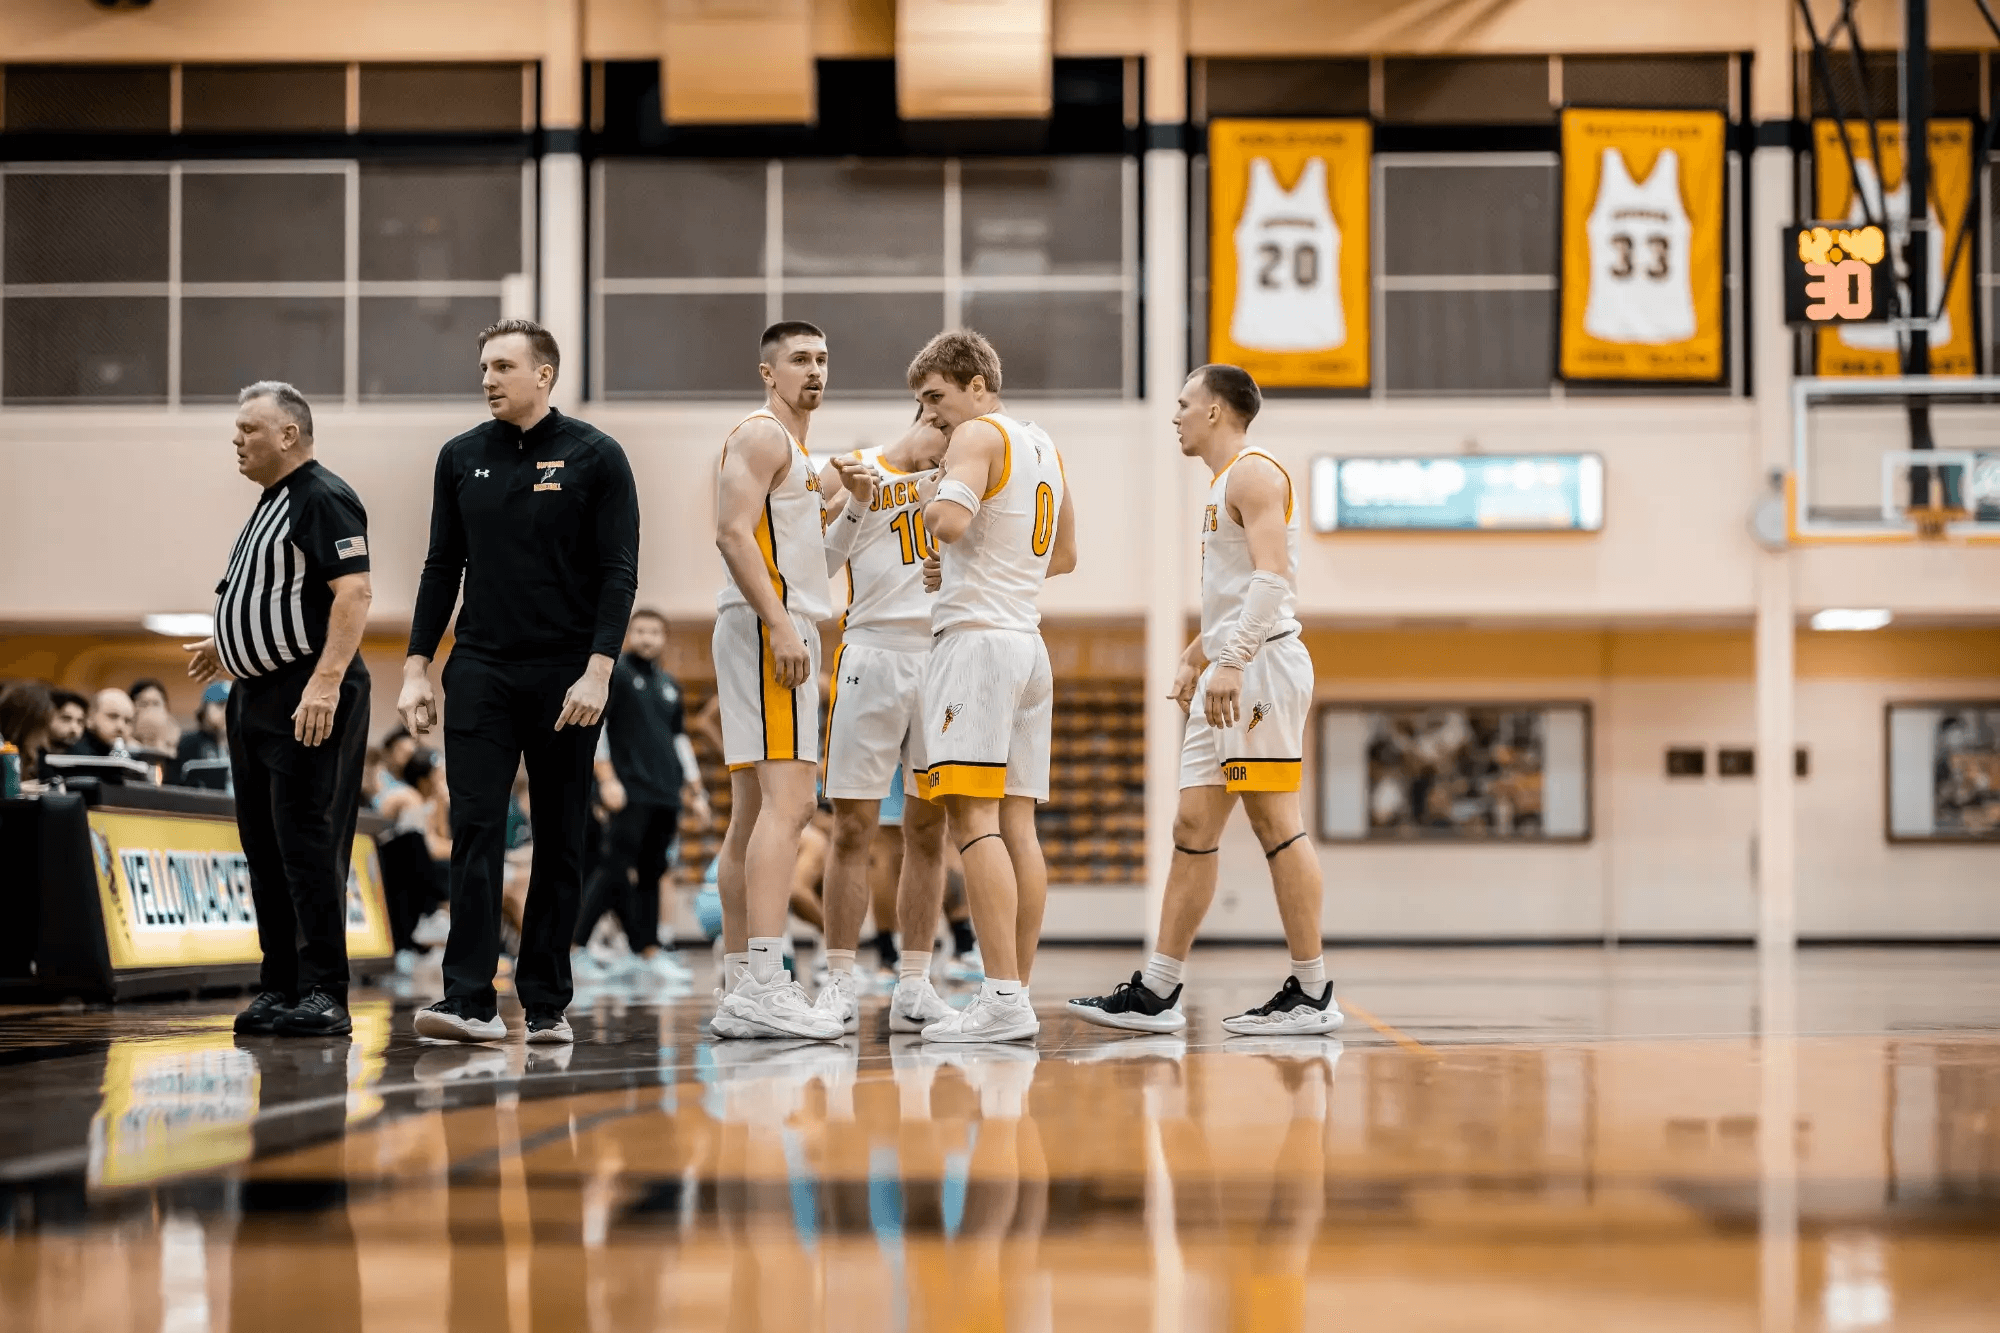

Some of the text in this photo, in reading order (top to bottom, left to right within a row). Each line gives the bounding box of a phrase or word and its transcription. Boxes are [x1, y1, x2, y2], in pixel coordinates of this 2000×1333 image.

[1258, 241, 1319, 287] 20
[1610, 232, 1669, 278] 33
[1805, 260, 1872, 320] 30
[1032, 482, 1054, 556] 0
